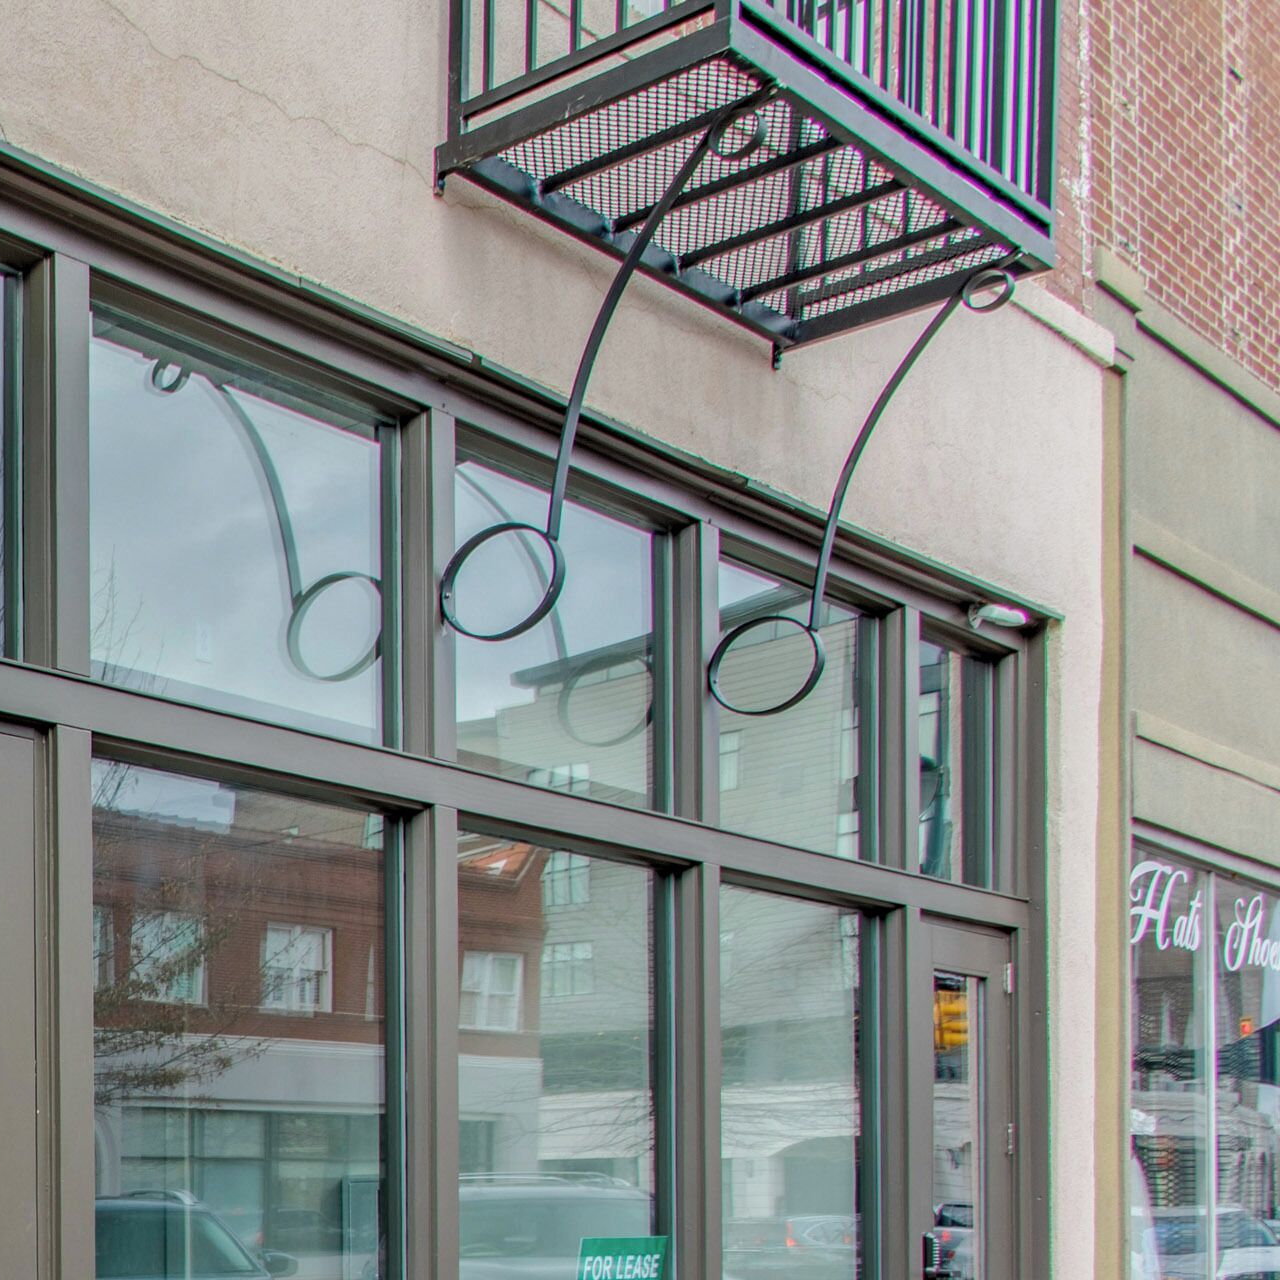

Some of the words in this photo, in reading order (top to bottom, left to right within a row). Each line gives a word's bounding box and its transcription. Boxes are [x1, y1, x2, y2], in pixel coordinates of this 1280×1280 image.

[1130, 861, 1202, 950] Hats
[1224, 895, 1280, 971] Shoe
[583, 1255, 613, 1280] FOR
[616, 1254, 660, 1279] LEASE
